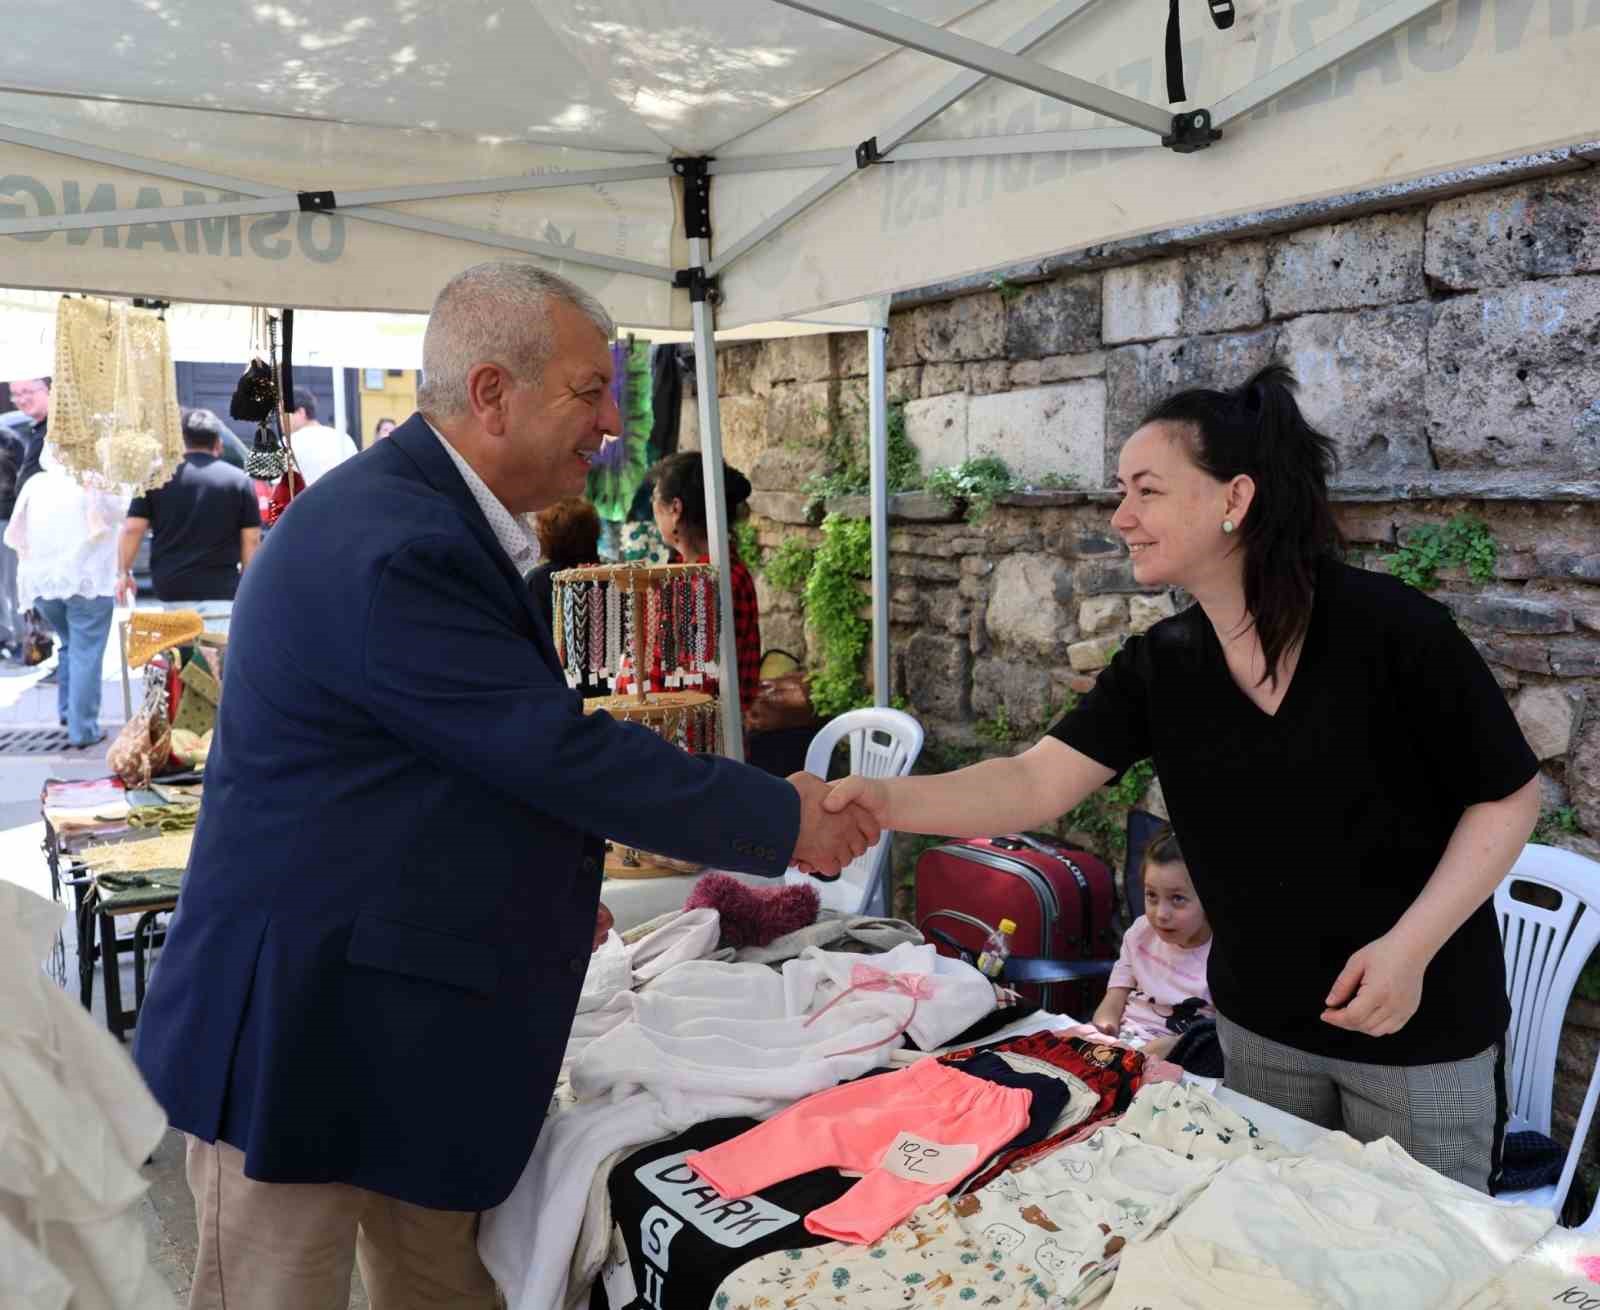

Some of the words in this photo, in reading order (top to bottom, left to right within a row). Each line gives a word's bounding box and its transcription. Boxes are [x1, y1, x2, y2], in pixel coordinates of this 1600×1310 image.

[898, 1140, 940, 1158] 100
[903, 1154, 929, 1175] TL
[655, 1162, 780, 1236] DARK
